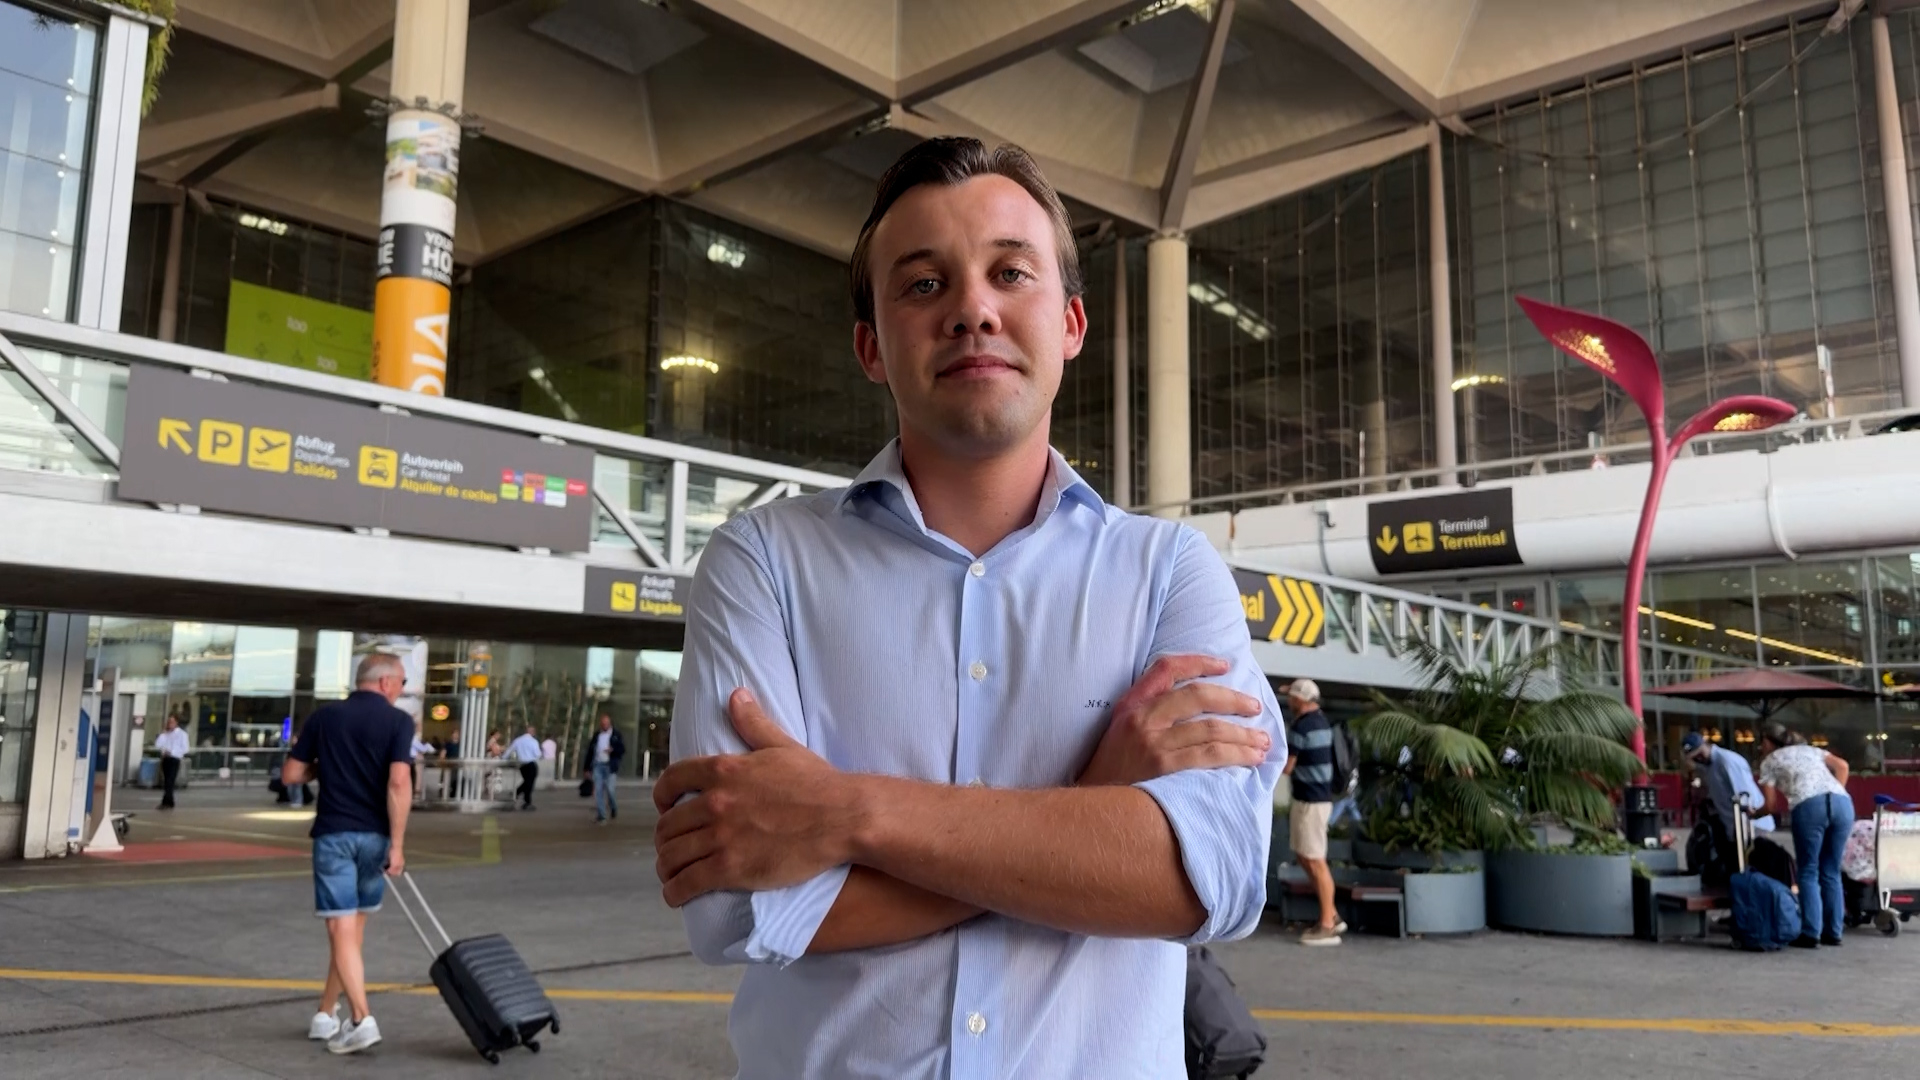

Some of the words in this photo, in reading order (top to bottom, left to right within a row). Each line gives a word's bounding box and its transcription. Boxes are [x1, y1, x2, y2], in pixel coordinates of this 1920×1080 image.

[211, 429, 232, 456] P
[295, 435, 336, 455] Abflug
[294, 448, 350, 468] Departures
[401, 452, 464, 474] Autoverleih
[293, 460, 339, 480] Salidas
[401, 465, 418, 478] Car
[420, 468, 451, 483] Rental
[400, 478, 443, 495] Alquiler
[444, 484, 459, 498] de
[461, 489, 498, 504] coches
[1438, 515, 1488, 534] Terminal
[1439, 529, 1507, 550] Terminal
[640, 599, 683, 615] Llegadas
